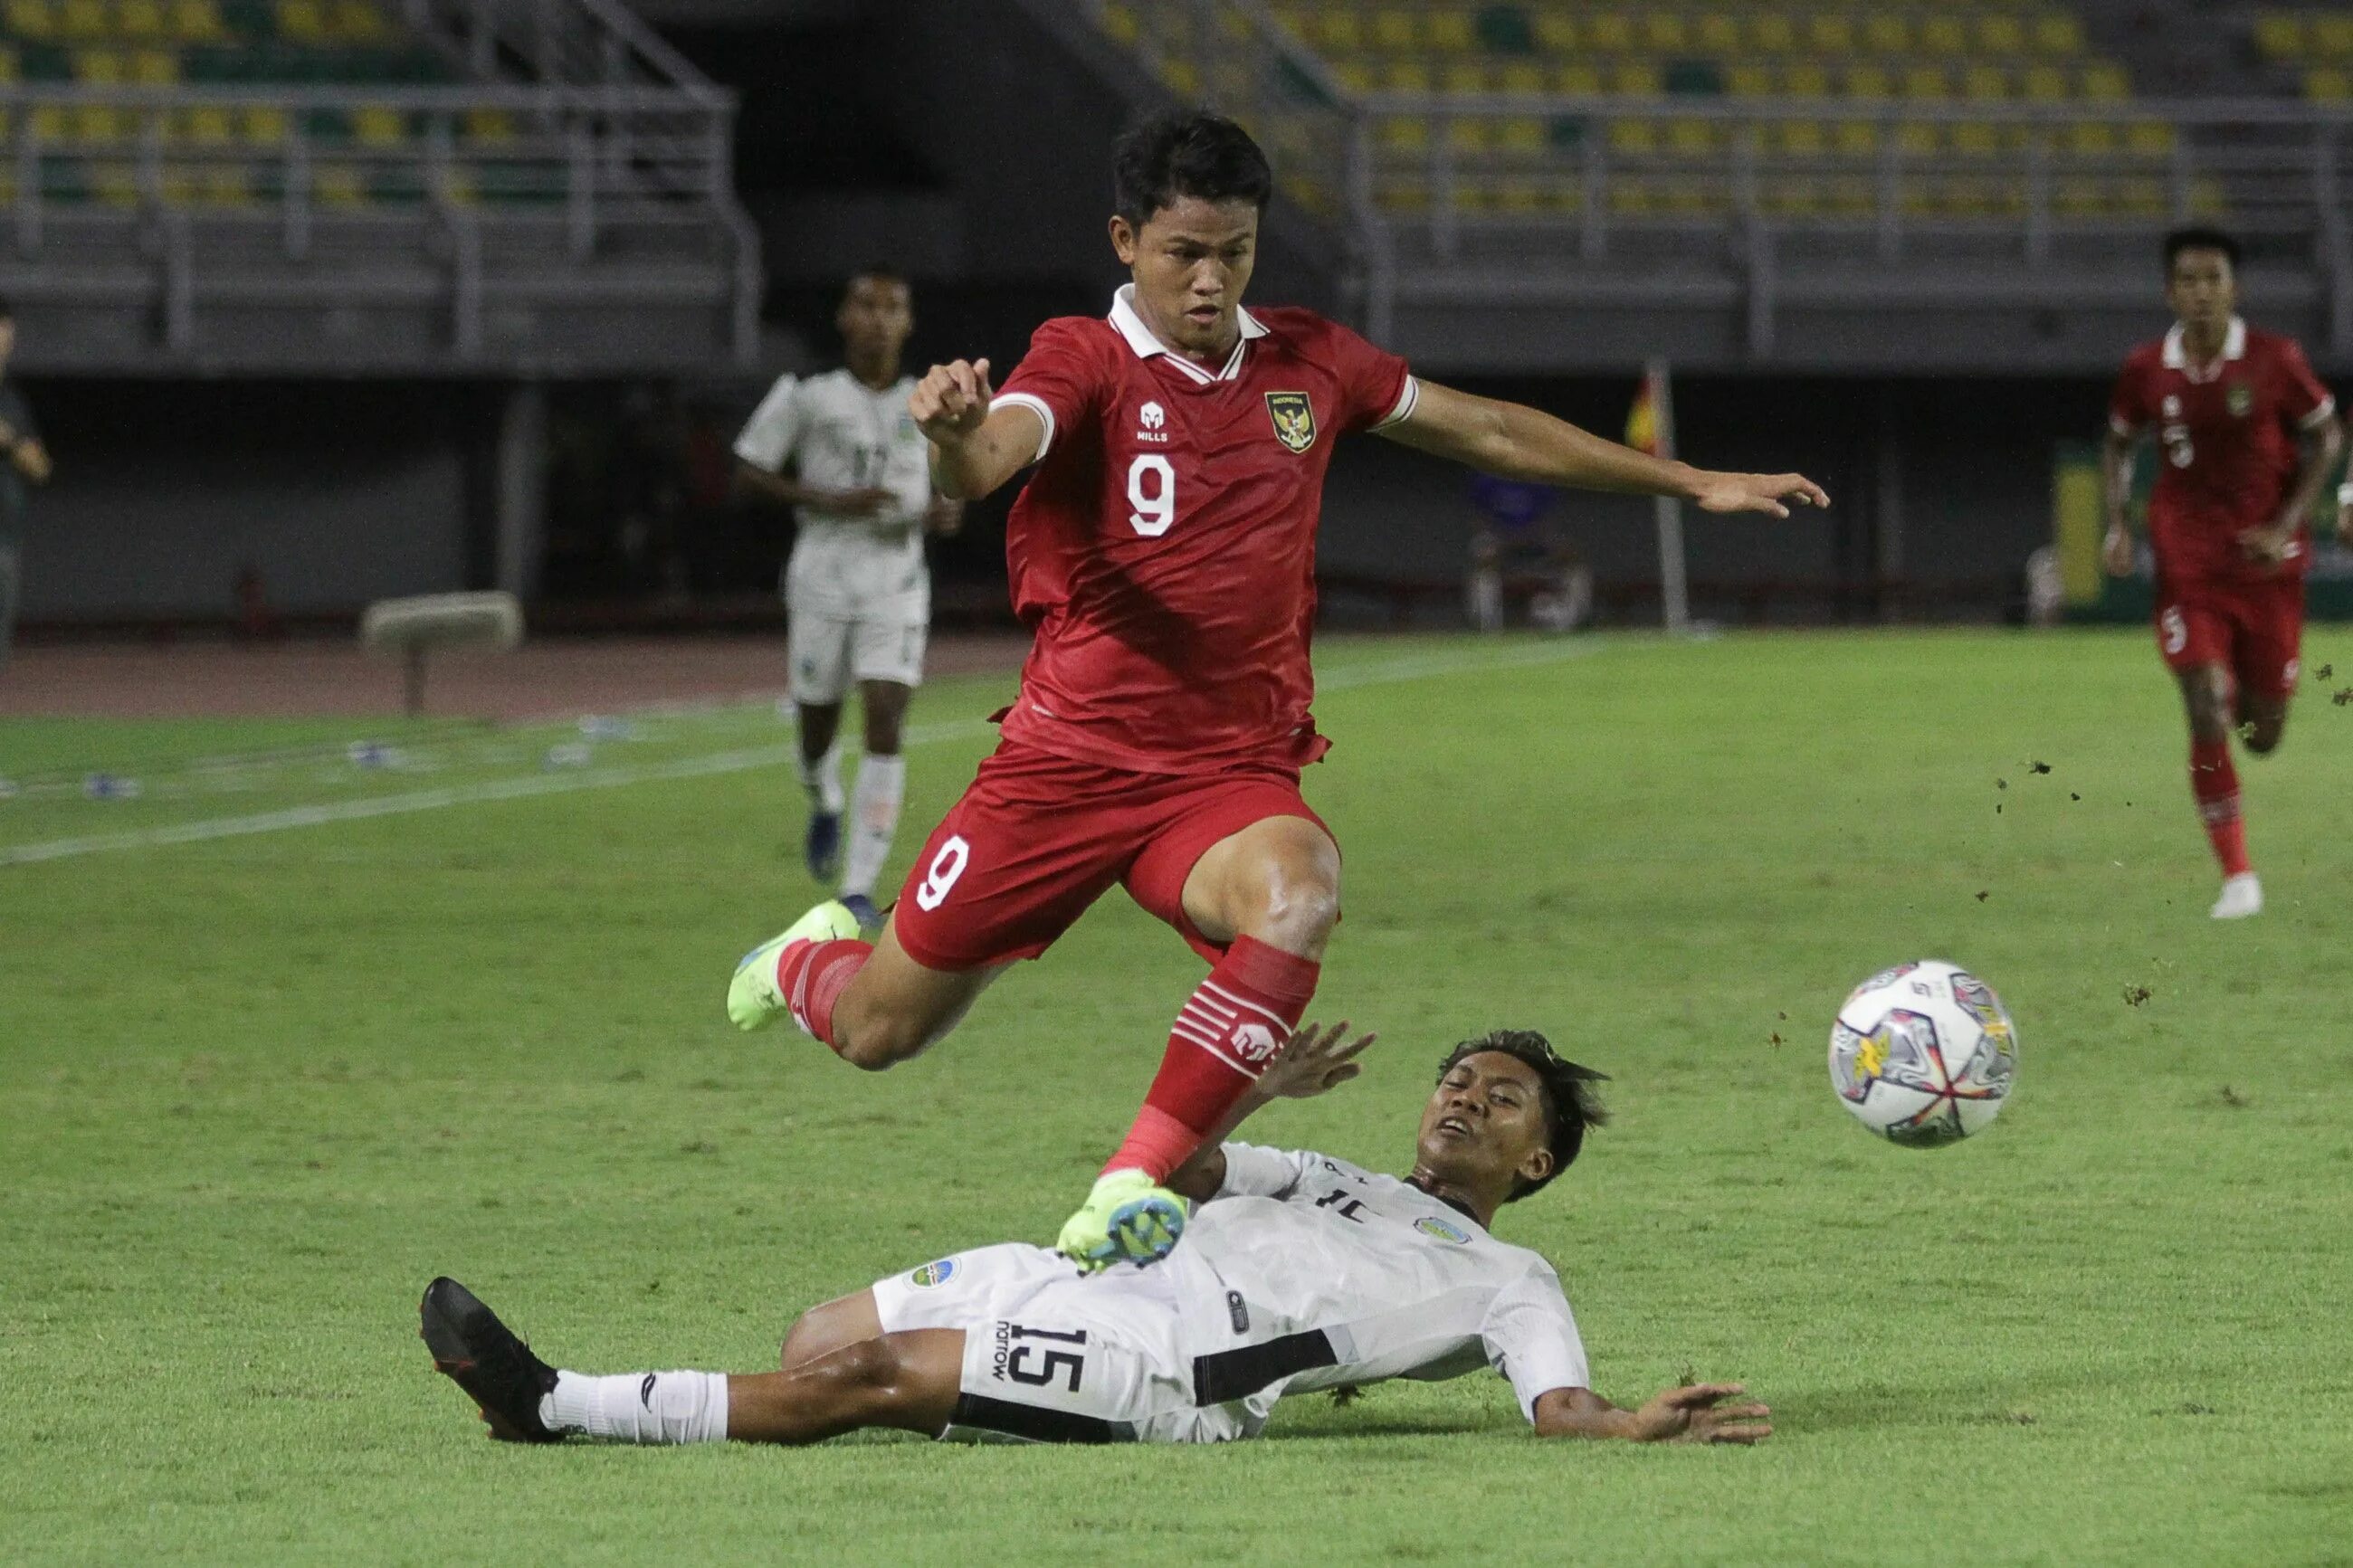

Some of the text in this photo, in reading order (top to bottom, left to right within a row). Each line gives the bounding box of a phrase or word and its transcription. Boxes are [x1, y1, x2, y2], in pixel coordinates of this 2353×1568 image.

[1137, 431, 1167, 442] MILLS
[2161, 423, 2195, 469] 5
[1128, 454, 1174, 536] 9
[917, 835, 969, 912] 9
[992, 1320, 1010, 1383] narrow
[1007, 1325, 1086, 1393] 15
